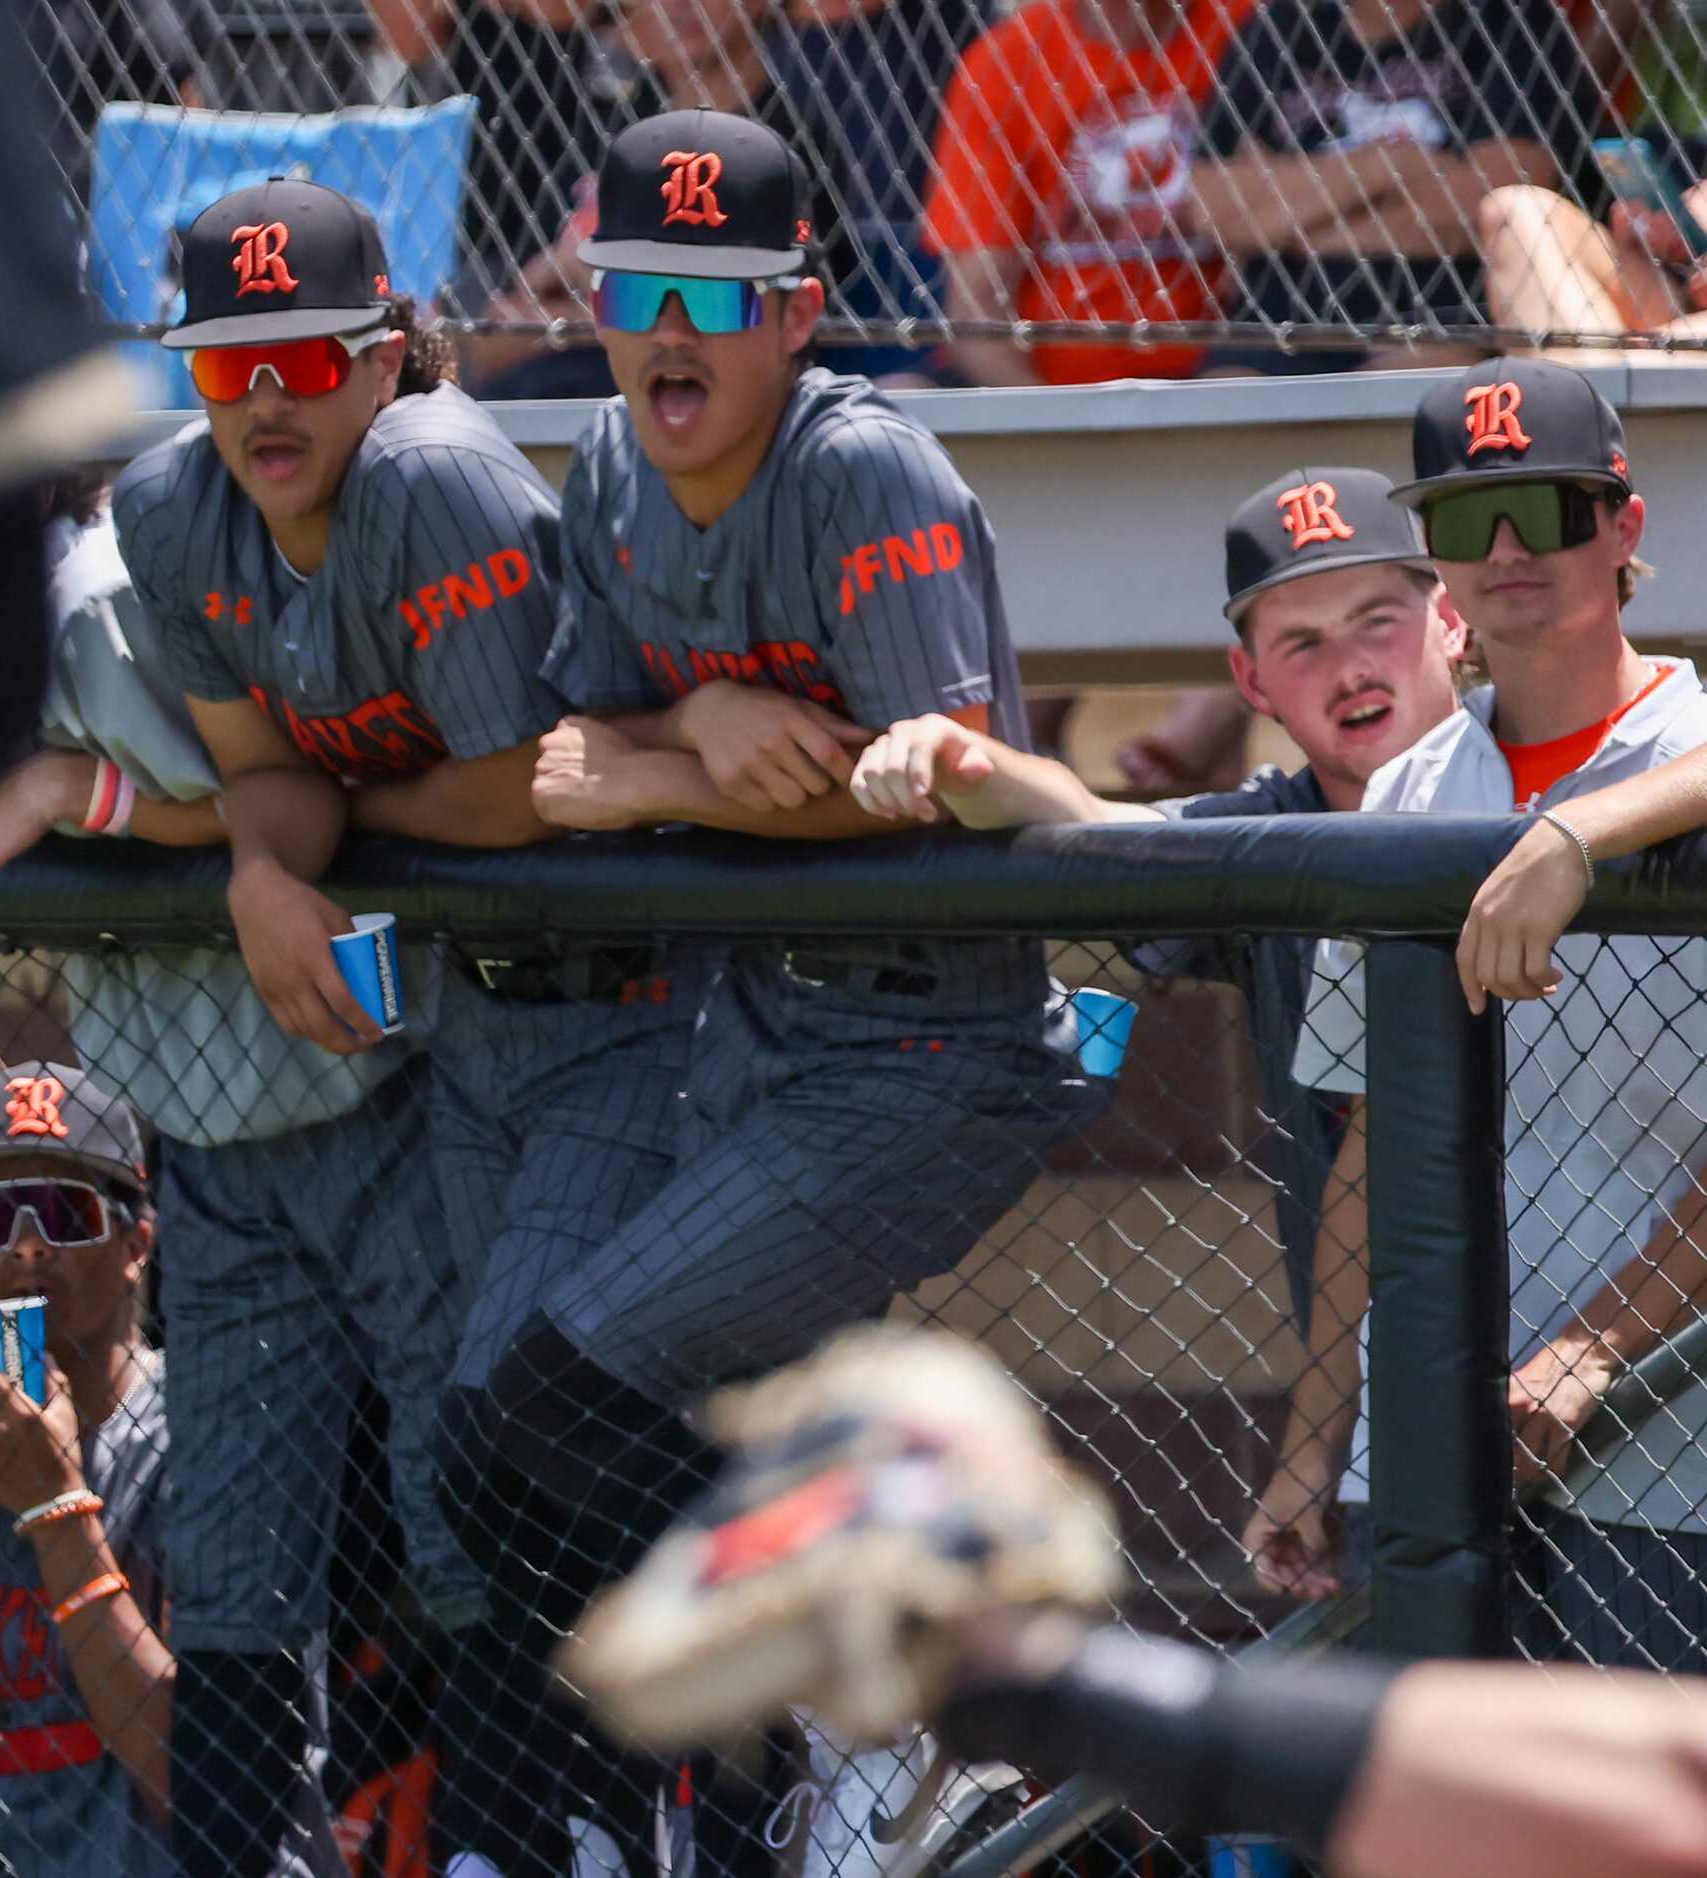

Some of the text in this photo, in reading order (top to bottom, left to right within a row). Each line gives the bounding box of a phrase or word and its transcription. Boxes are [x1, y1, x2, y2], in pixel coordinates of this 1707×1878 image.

[660, 150, 729, 228] R
[230, 221, 300, 297] R
[1464, 381, 1534, 457] R
[1276, 481, 1355, 549] R
[398, 548, 531, 650] JFND
[4, 1076, 70, 1139] R
